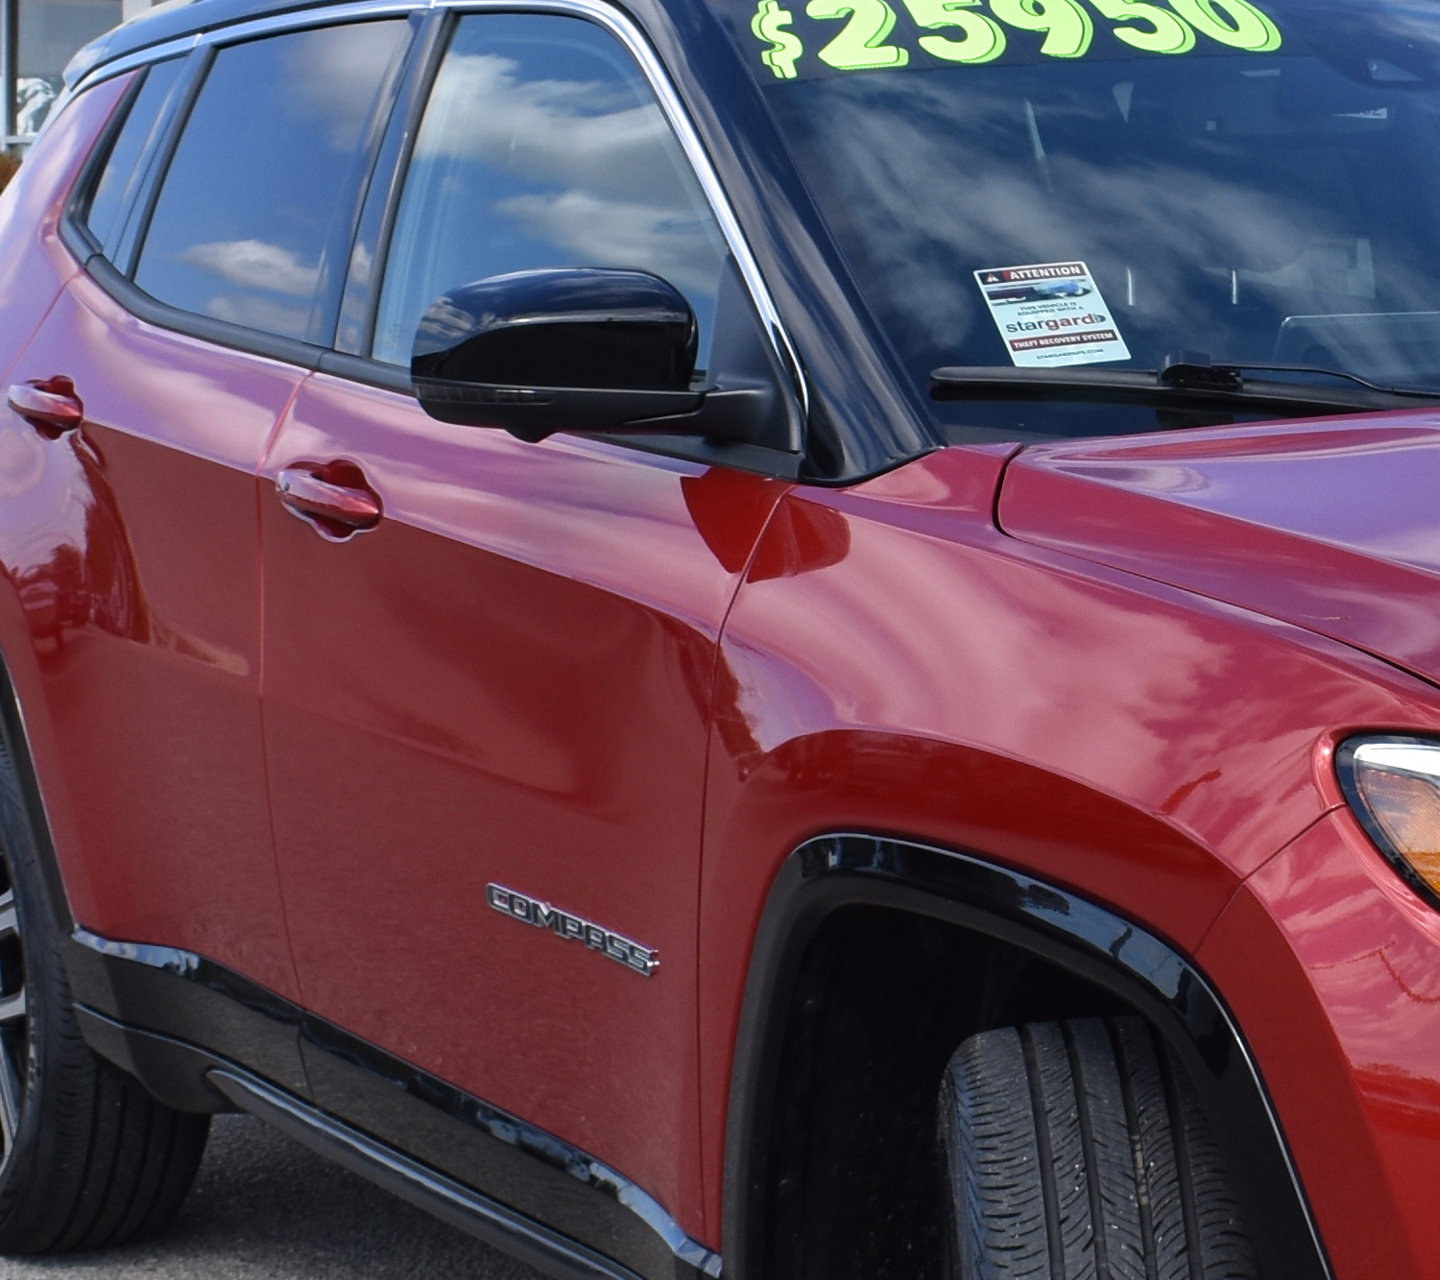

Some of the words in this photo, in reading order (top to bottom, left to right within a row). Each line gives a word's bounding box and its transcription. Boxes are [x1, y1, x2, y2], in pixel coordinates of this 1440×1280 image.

[1009, 265, 1081, 281] ATTENTION
[1006, 313, 1096, 333] stargard
[1040, 335, 1081, 346] RECOVERY
[1082, 332, 1114, 341] SYSTEM
[485, 882, 660, 977] COMPASS
